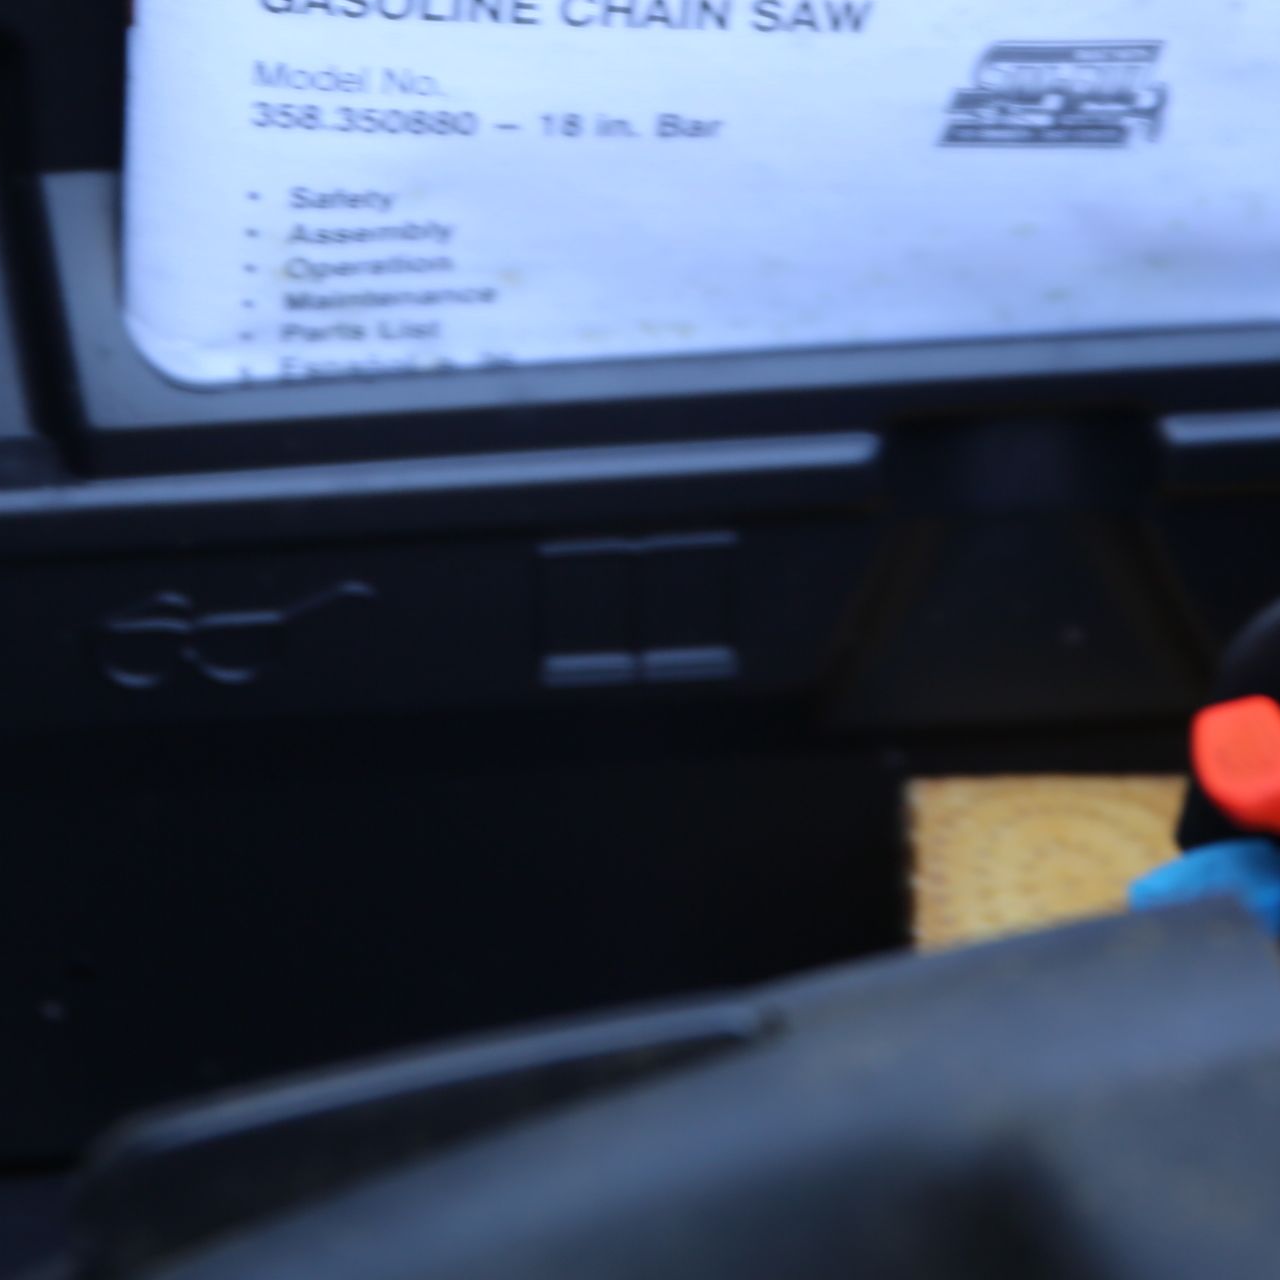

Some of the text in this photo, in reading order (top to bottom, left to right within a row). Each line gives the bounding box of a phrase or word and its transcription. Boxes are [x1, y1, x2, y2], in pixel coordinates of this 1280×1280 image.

[251, 60, 450, 99] Model No.
[653, 111, 726, 140] Bar
[288, 184, 399, 213] Safety
[284, 220, 455, 246] Assembly
[281, 255, 456, 283] Operation
[282, 286, 500, 312] Maintenance
[278, 320, 368, 344] Parts
